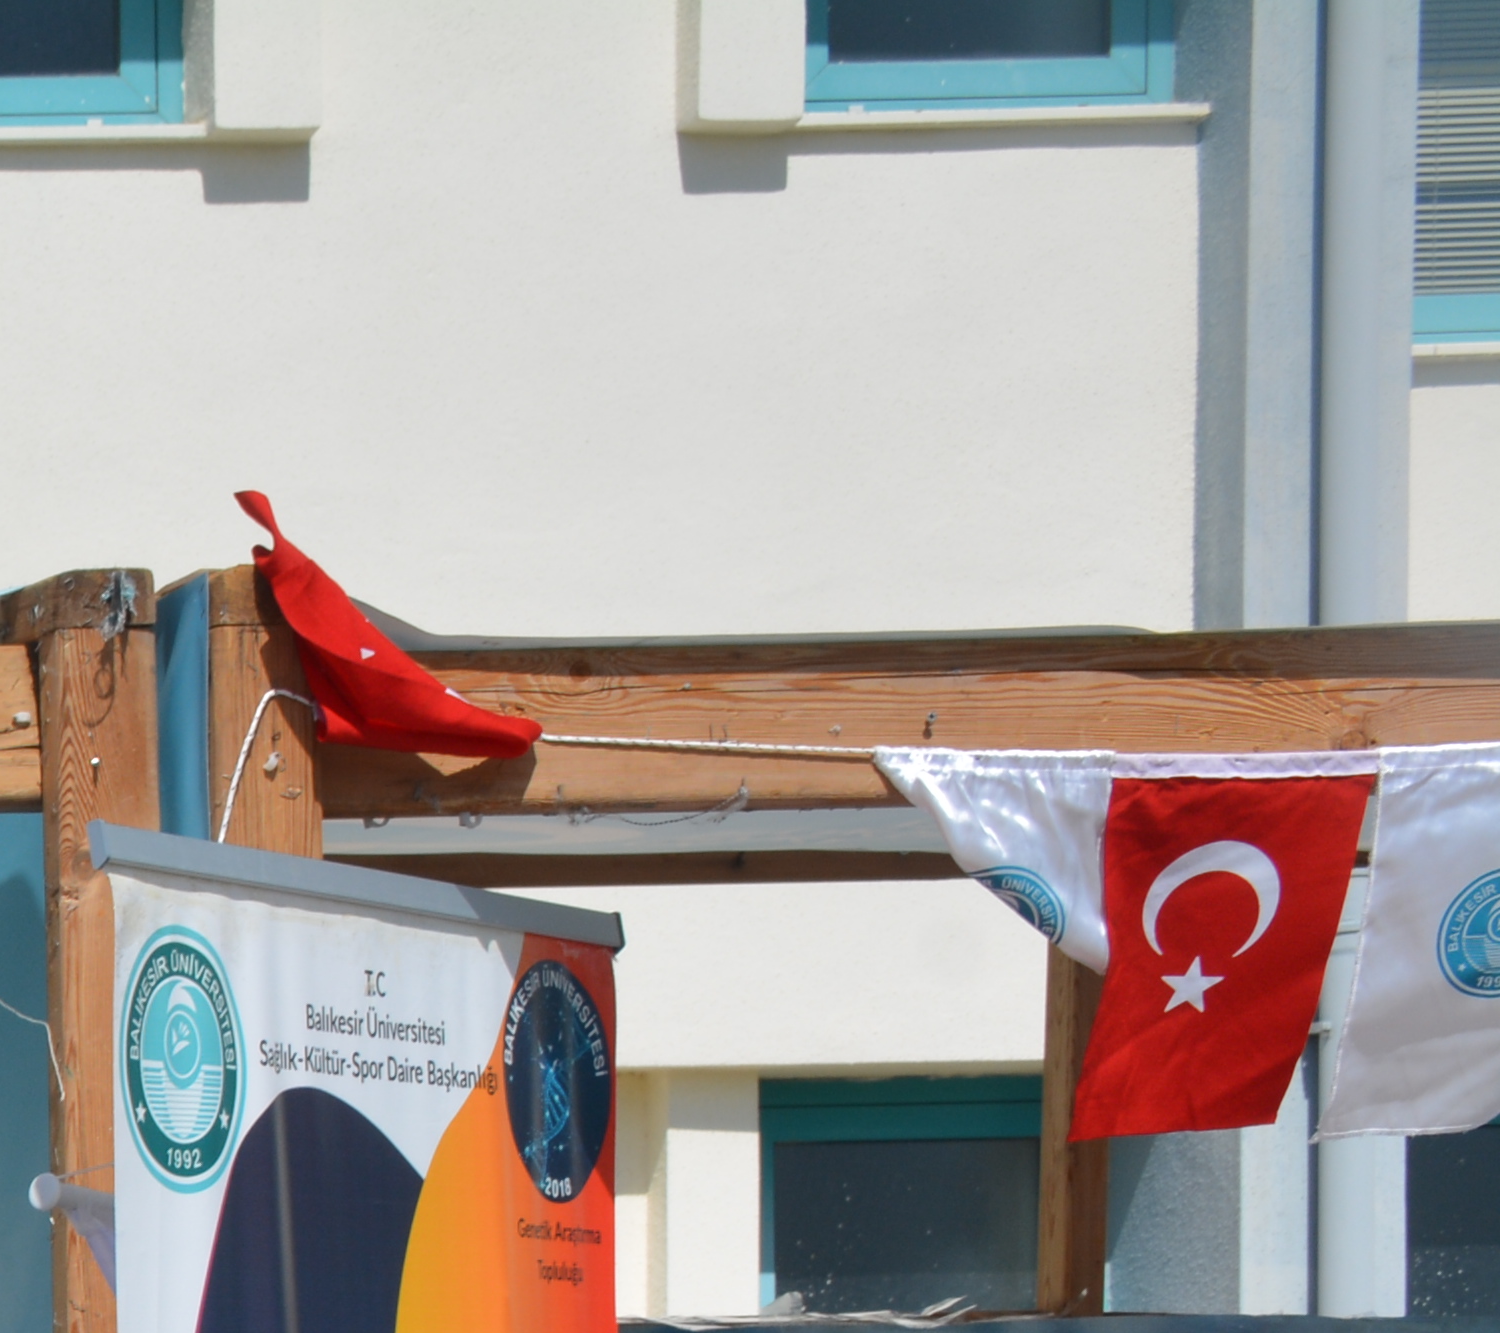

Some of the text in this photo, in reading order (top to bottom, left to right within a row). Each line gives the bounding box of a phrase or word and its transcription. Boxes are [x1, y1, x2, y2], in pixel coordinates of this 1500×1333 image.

[1447, 883, 1497, 953] BALIKESİR
[129, 950, 237, 1071] BALIKESİR ÜNİVERSİTESİ
[306, 1003, 445, 1046] Balıkesir Üniversitesi
[503, 963, 609, 1077] BALIKESİR ÜNİVERSİTESİ
[259, 1040, 499, 1095] Sağlık-Kültür-Spor Daire Başkanlığı
[166, 1147, 203, 1170] 1992
[544, 1176, 572, 1198] 2018
[517, 1218, 602, 1247] Genetik Araştırma
[537, 1259, 584, 1288] Topluluğu
